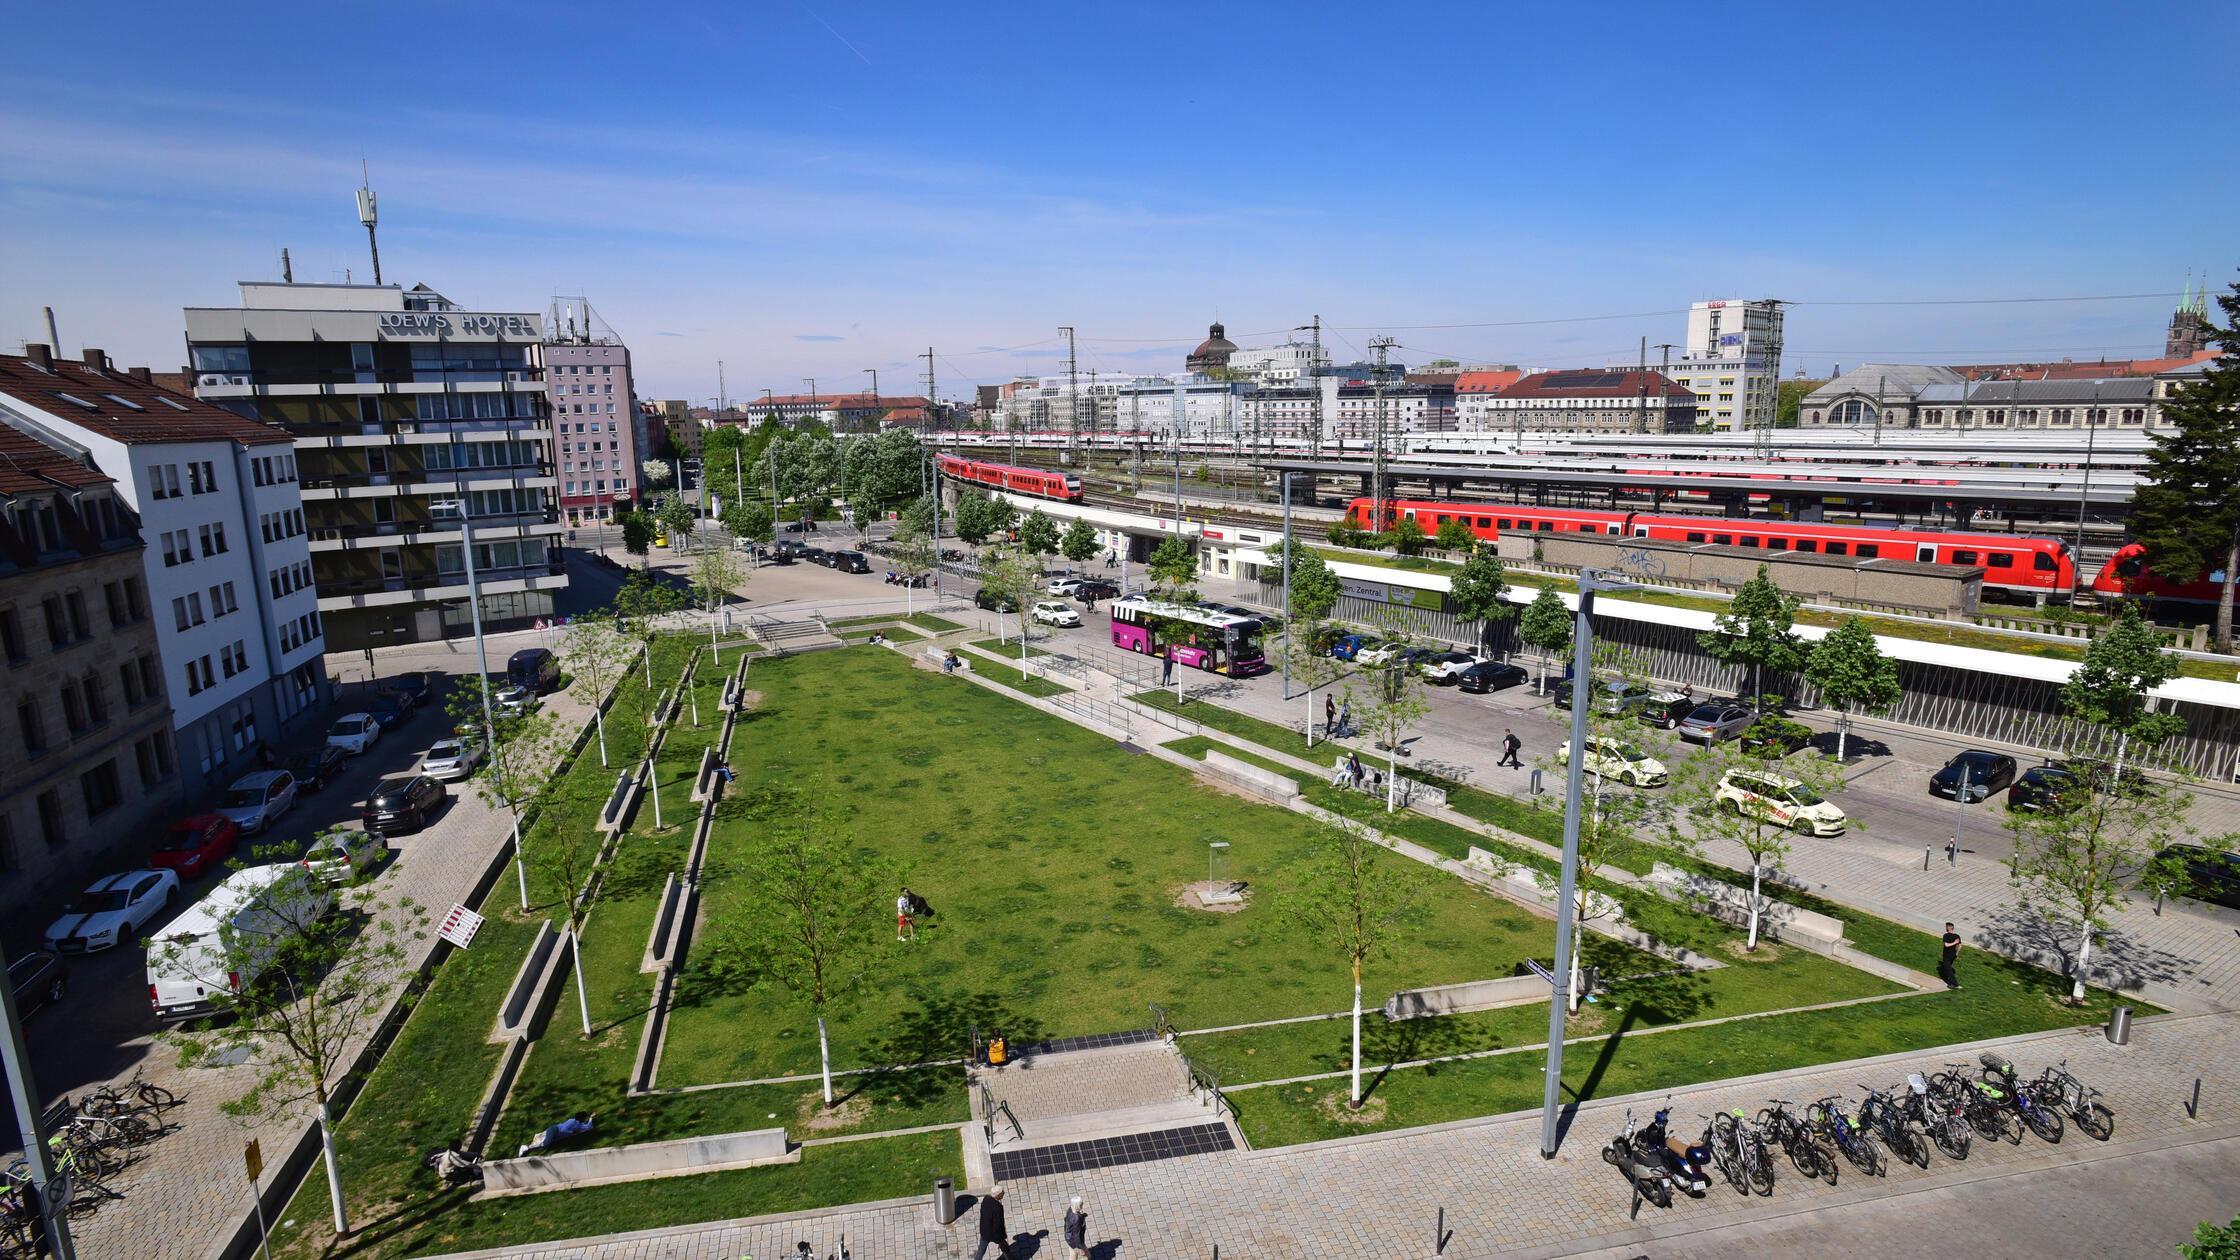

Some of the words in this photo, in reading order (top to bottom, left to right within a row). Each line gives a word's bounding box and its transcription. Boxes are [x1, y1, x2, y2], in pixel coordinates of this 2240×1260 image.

[378, 314, 448, 329] LOEW'S
[461, 314, 532, 330] HOTEL
[1720, 335, 1742, 346] DIEHL
